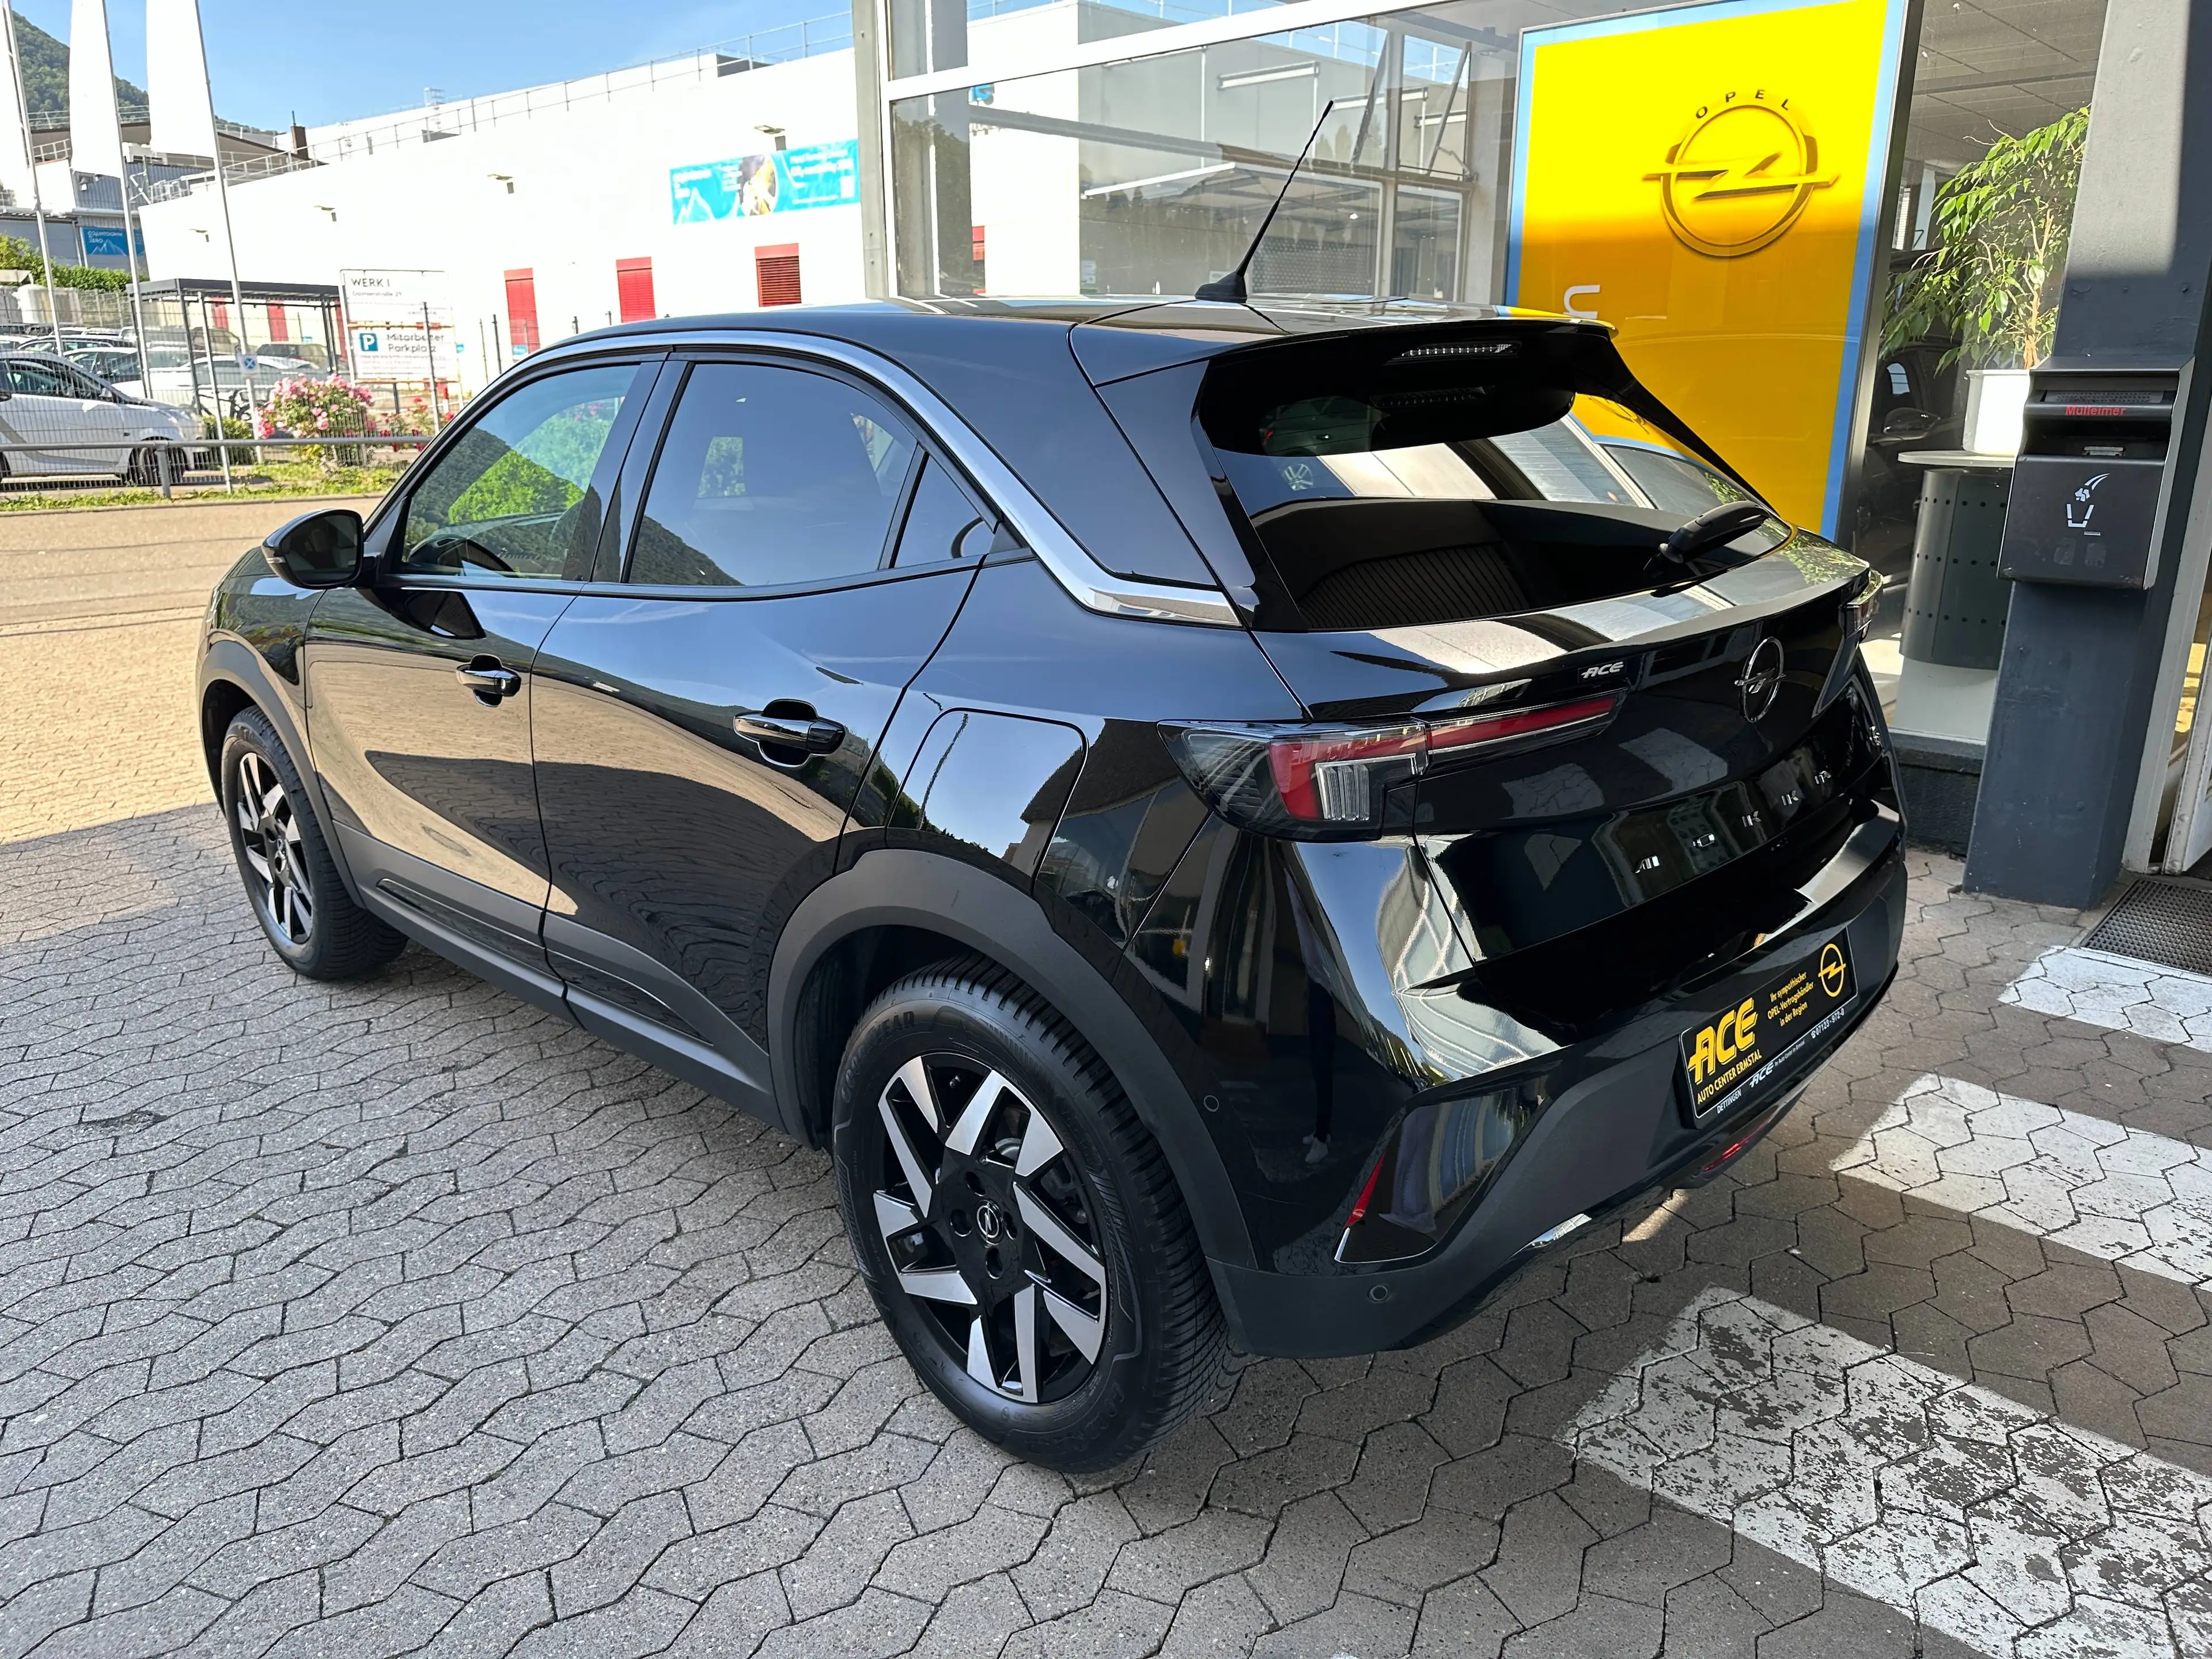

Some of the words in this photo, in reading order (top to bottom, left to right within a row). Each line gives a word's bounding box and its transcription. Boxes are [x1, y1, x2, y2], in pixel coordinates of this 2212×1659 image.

[1695, 89, 1789, 119] OPEL
[350, 278, 384, 287] WERK
[362, 334, 375, 350] P
[388, 344, 437, 353] Parkplaz
[2065, 405, 2126, 416] Mülleimer
[1581, 661, 1624, 679] ACE
[1777, 972, 1806, 998] sympathischer
[1779, 1018, 1785, 1027] in
[1785, 1013, 1793, 1023] der
[1792, 1002, 1808, 1017] Region
[1688, 998, 1758, 1085] ACE
[1698, 1084, 1714, 1105] AUTO
[1714, 1067, 1737, 1090] CENTER
[1736, 1049, 1762, 1075] ERMSTAL
[1749, 1062, 1774, 1088] ACE
[1717, 1088, 1742, 1114] DETTINGEN
